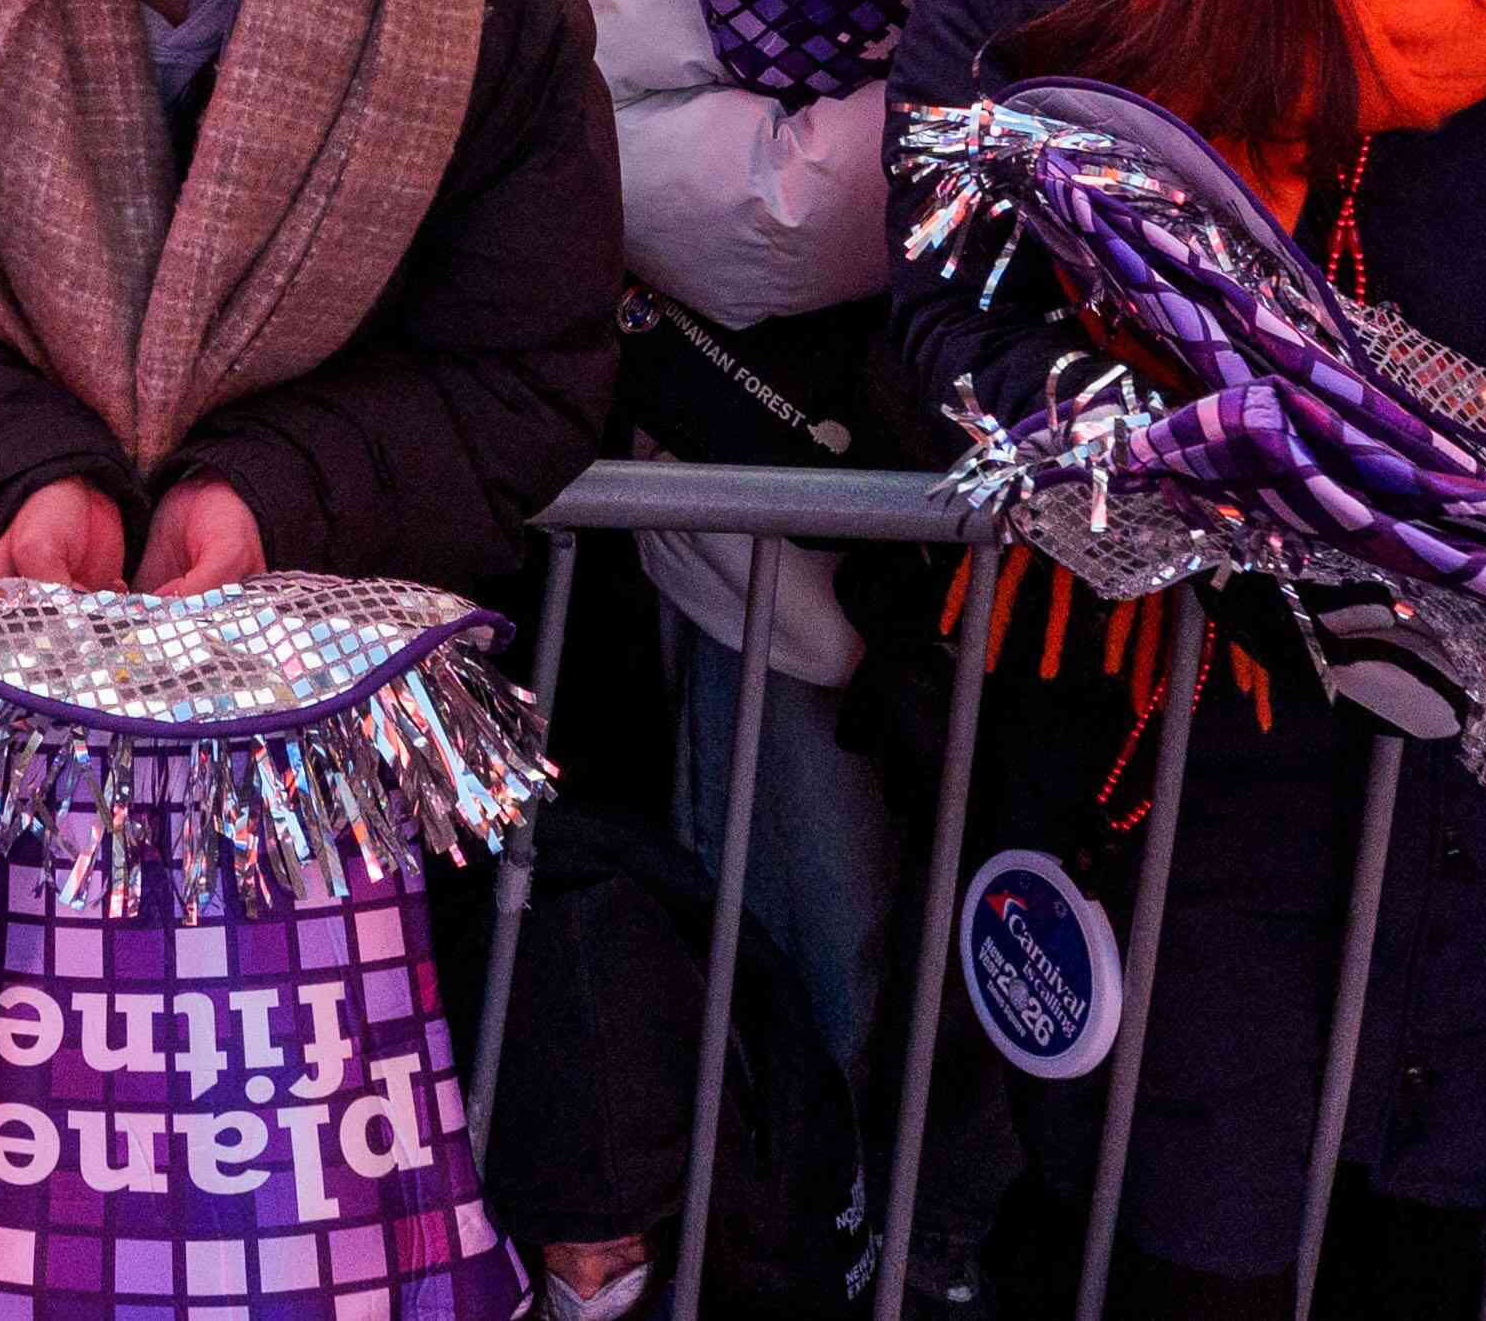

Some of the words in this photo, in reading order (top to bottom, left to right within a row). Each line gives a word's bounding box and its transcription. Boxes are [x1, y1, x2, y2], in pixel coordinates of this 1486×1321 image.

[734, 367, 807, 428] FOREST
[979, 946, 1001, 977] Year
[982, 936, 1006, 970] New
[1008, 913, 1087, 1022] Carnival
